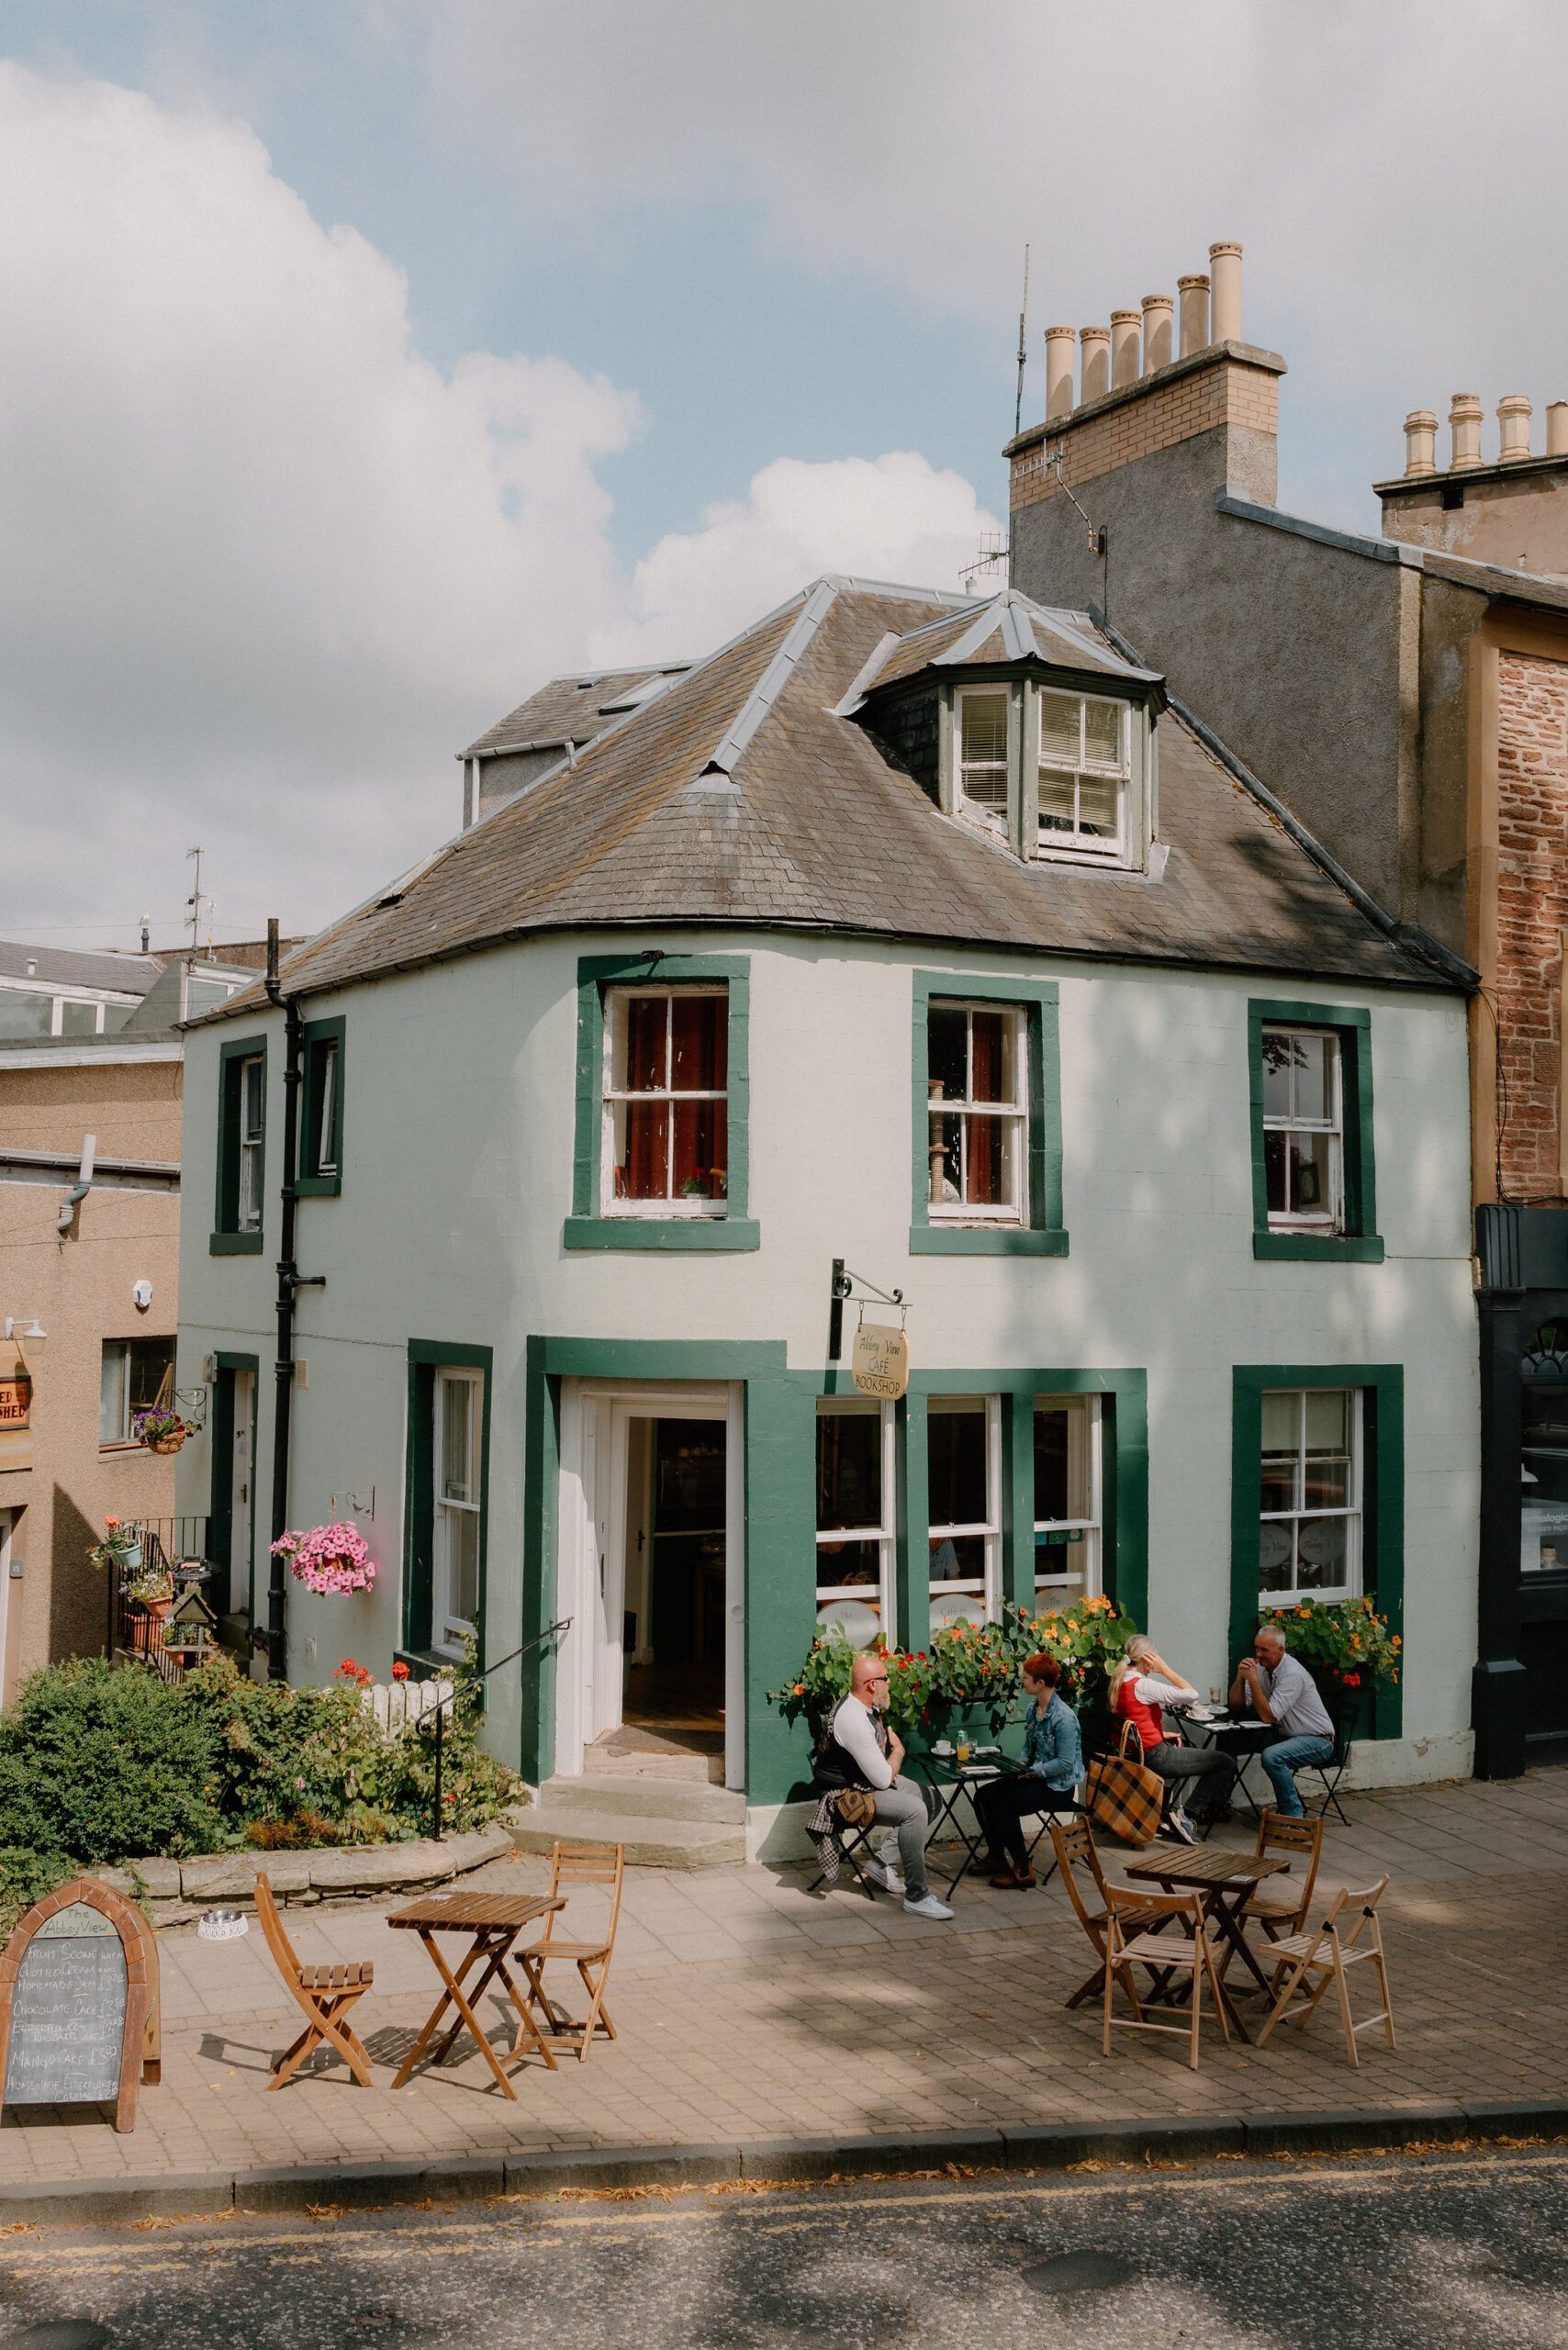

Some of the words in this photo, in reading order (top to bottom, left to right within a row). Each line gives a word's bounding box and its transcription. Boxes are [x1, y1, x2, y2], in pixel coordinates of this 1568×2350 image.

[859, 1335, 880, 1359] Abbey
[885, 1339, 901, 1356] View
[868, 1357, 889, 1374] CAFÉ
[856, 1375, 901, 1395] BOOKSHOP
[1049, 1596, 1062, 1606] The
[67, 1908, 89, 1919] The
[44, 1918, 80, 1936] Abbey
[80, 1920, 108, 1933] View
[27, 1944, 55, 1960] FRUIT
[61, 1941, 98, 1961] SCONE
[13, 1999, 71, 2017] CHOCOLATE
[12, 2049, 56, 2070] MANGO
[58, 2048, 86, 2065] CAKE
